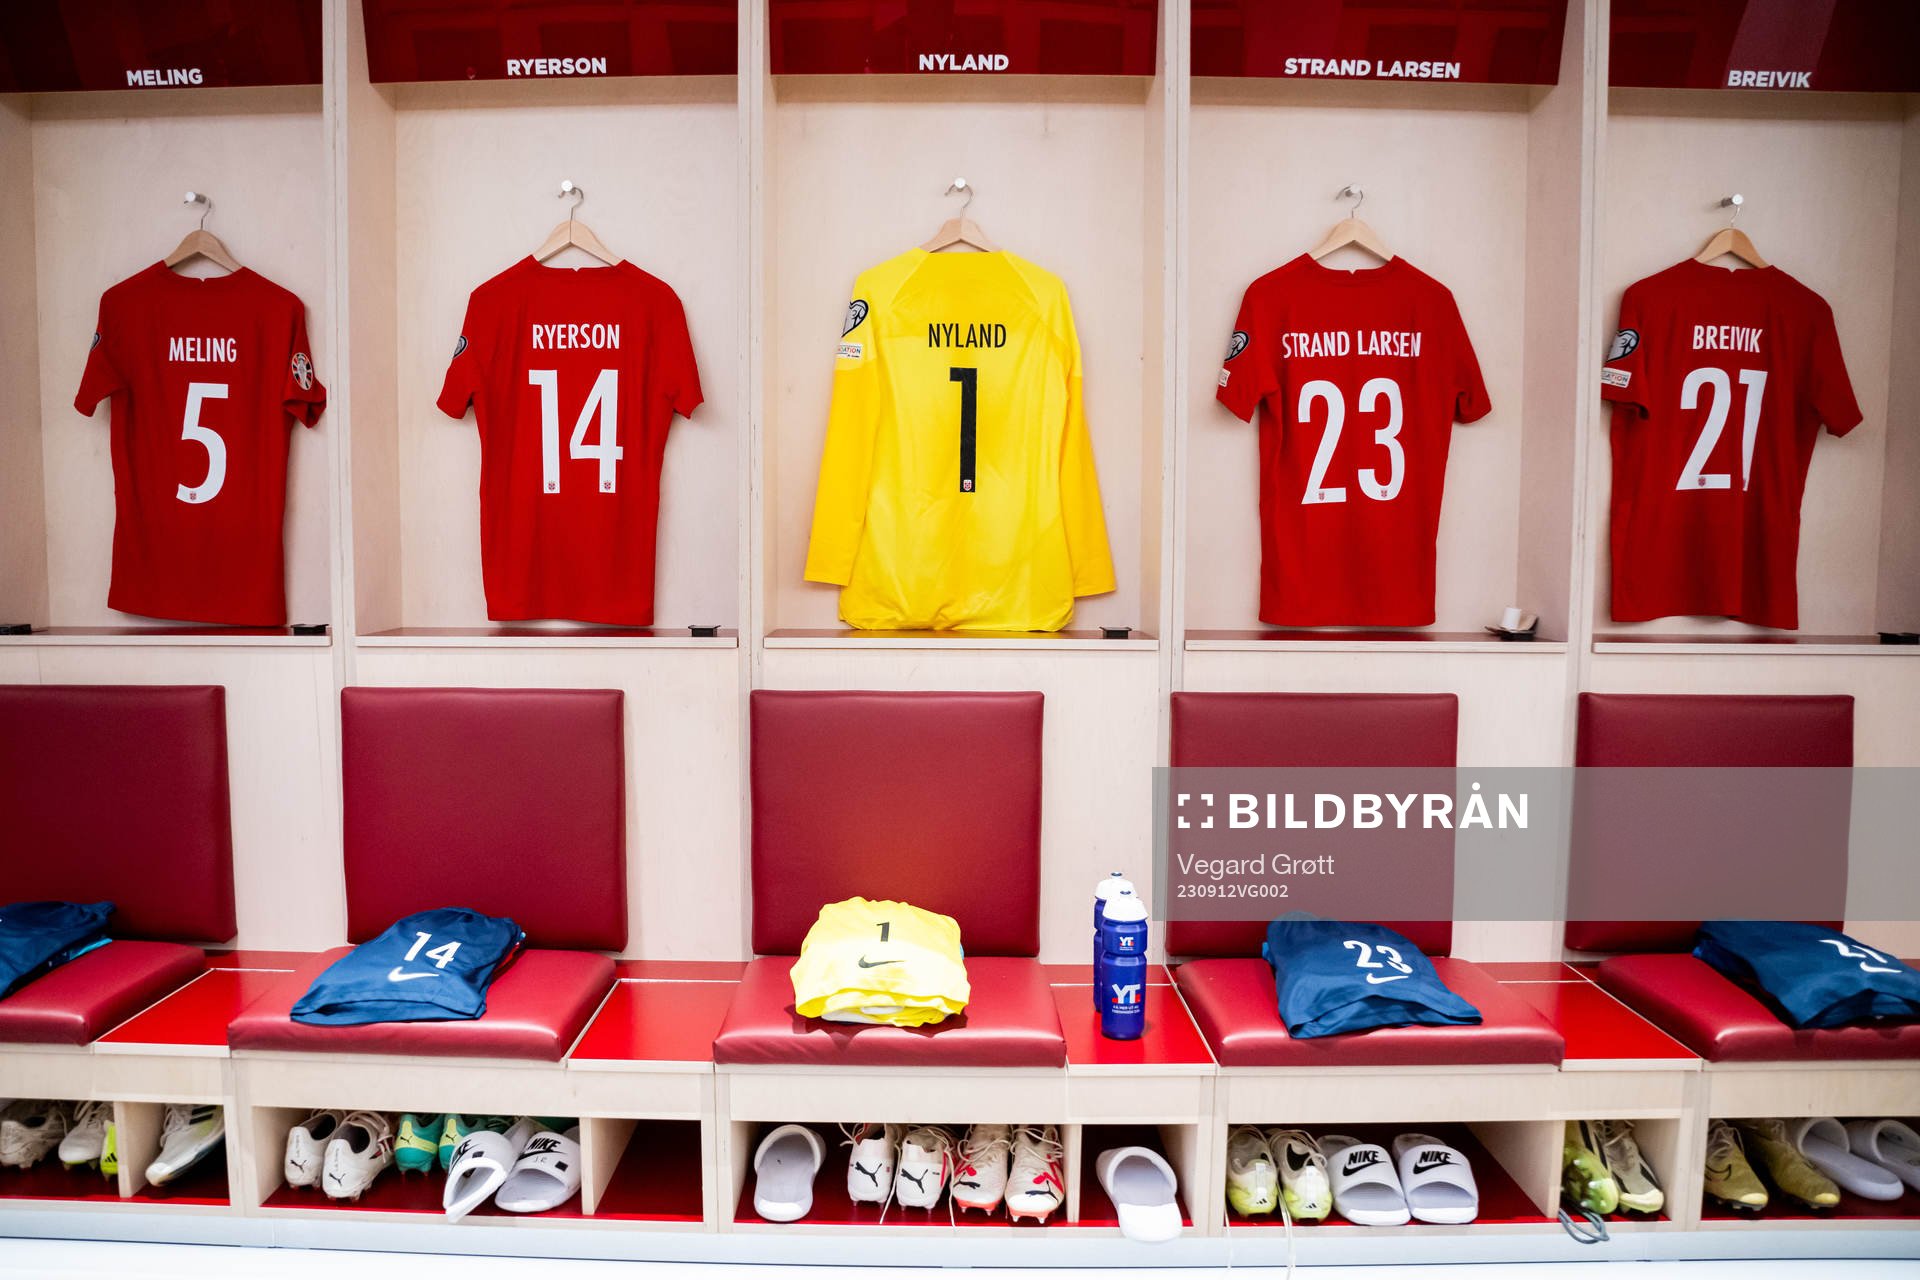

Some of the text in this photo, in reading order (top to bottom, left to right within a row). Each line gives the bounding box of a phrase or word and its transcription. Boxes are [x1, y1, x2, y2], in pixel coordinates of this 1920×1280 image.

[506, 57, 607, 76] RYERSON
[919, 53, 1009, 71] NYLAND
[1284, 57, 1461, 79] STRAND LARSEN
[126, 68, 203, 86] MELING
[1727, 70, 1812, 88] BREIVIK
[532, 323, 620, 350] RYERSON
[928, 323, 1007, 348] NYLAND
[1282, 330, 1422, 359] STRAND LARSEN
[1692, 325, 1763, 353] BREIVIK
[168, 337, 237, 363] MELING
[528, 368, 624, 494] 14
[949, 367, 978, 493] 1
[1297, 377, 1405, 505] 23
[1675, 367, 1768, 492] 21
[175, 382, 229, 504] 5
[876, 921, 890, 942] 1
[403, 931, 462, 970] 14
[1342, 939, 1414, 974] 23
[1111, 983, 1141, 1004] YT
[527, 1137, 562, 1152] NIKE
[1418, 1150, 1452, 1164] NIKE
[1348, 1150, 1380, 1165] NIKE
